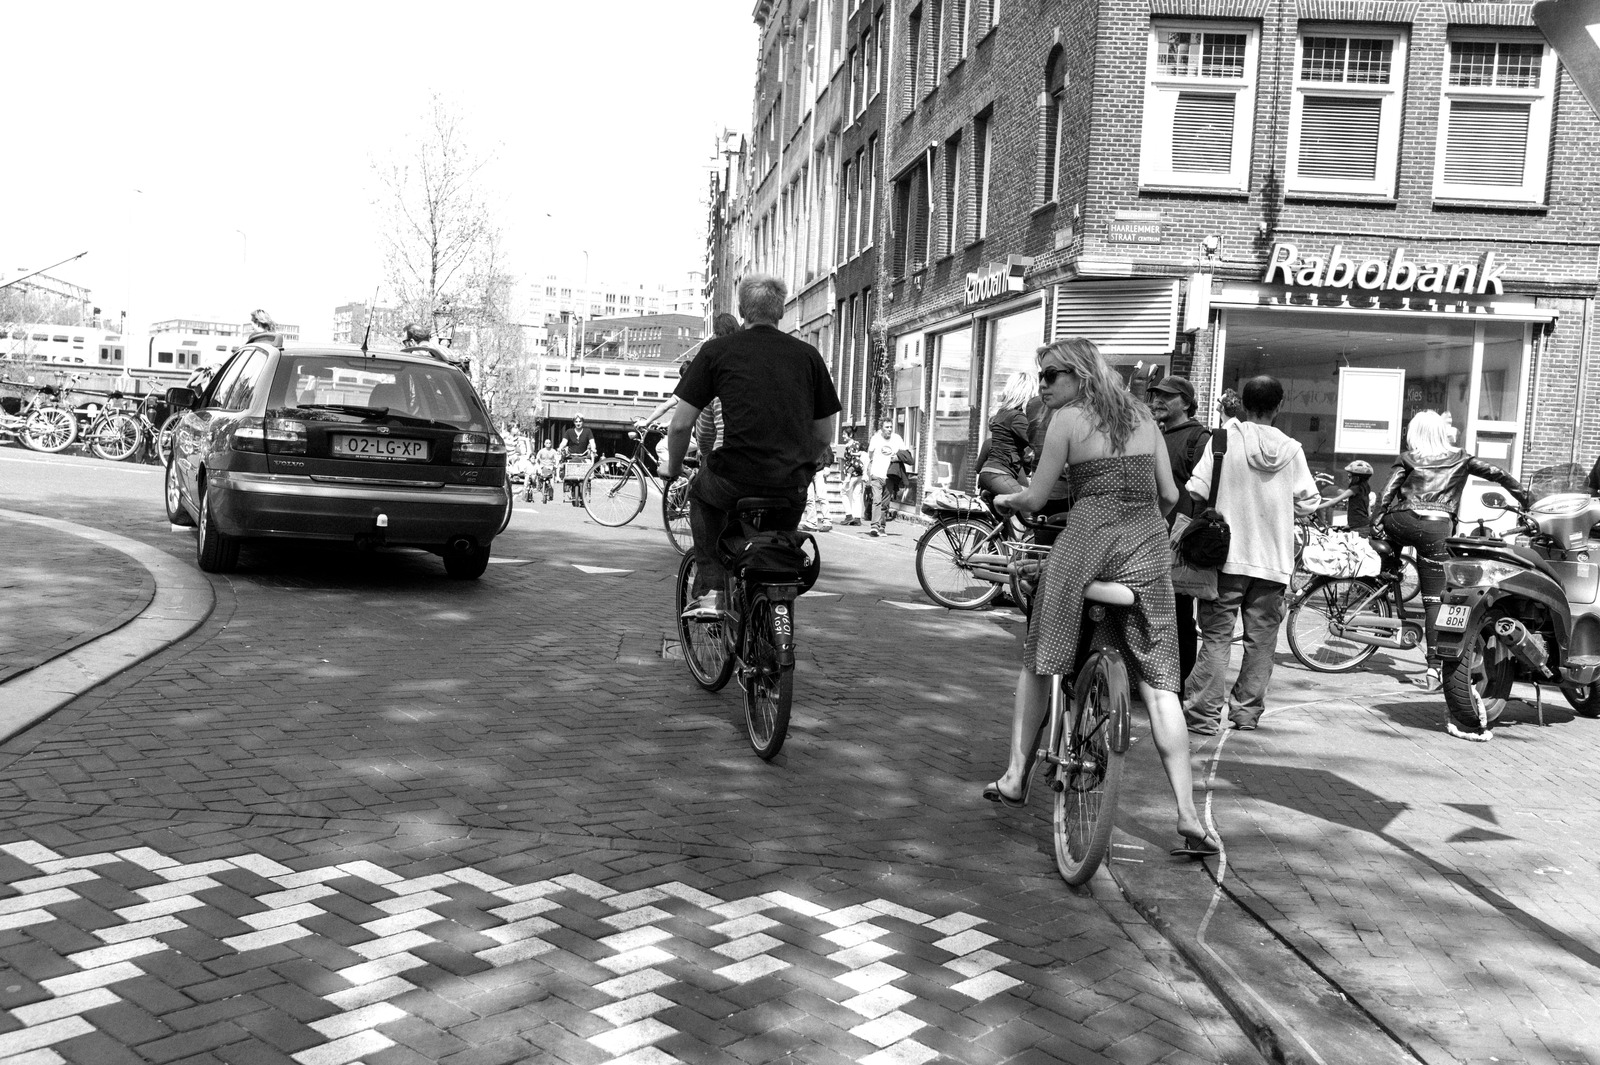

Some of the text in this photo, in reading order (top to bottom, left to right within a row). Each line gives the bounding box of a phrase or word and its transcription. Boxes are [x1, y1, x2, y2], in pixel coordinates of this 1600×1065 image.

[1110, 224, 1160, 234] HAARLEMMER
[1110, 233, 1136, 241] STRAAT
[1263, 243, 1507, 295] Rabobank
[1407, 388, 1422, 402] Kies
[348, 438, 422, 456] 02-LG-XP
[273, 460, 305, 468] VOLVO
